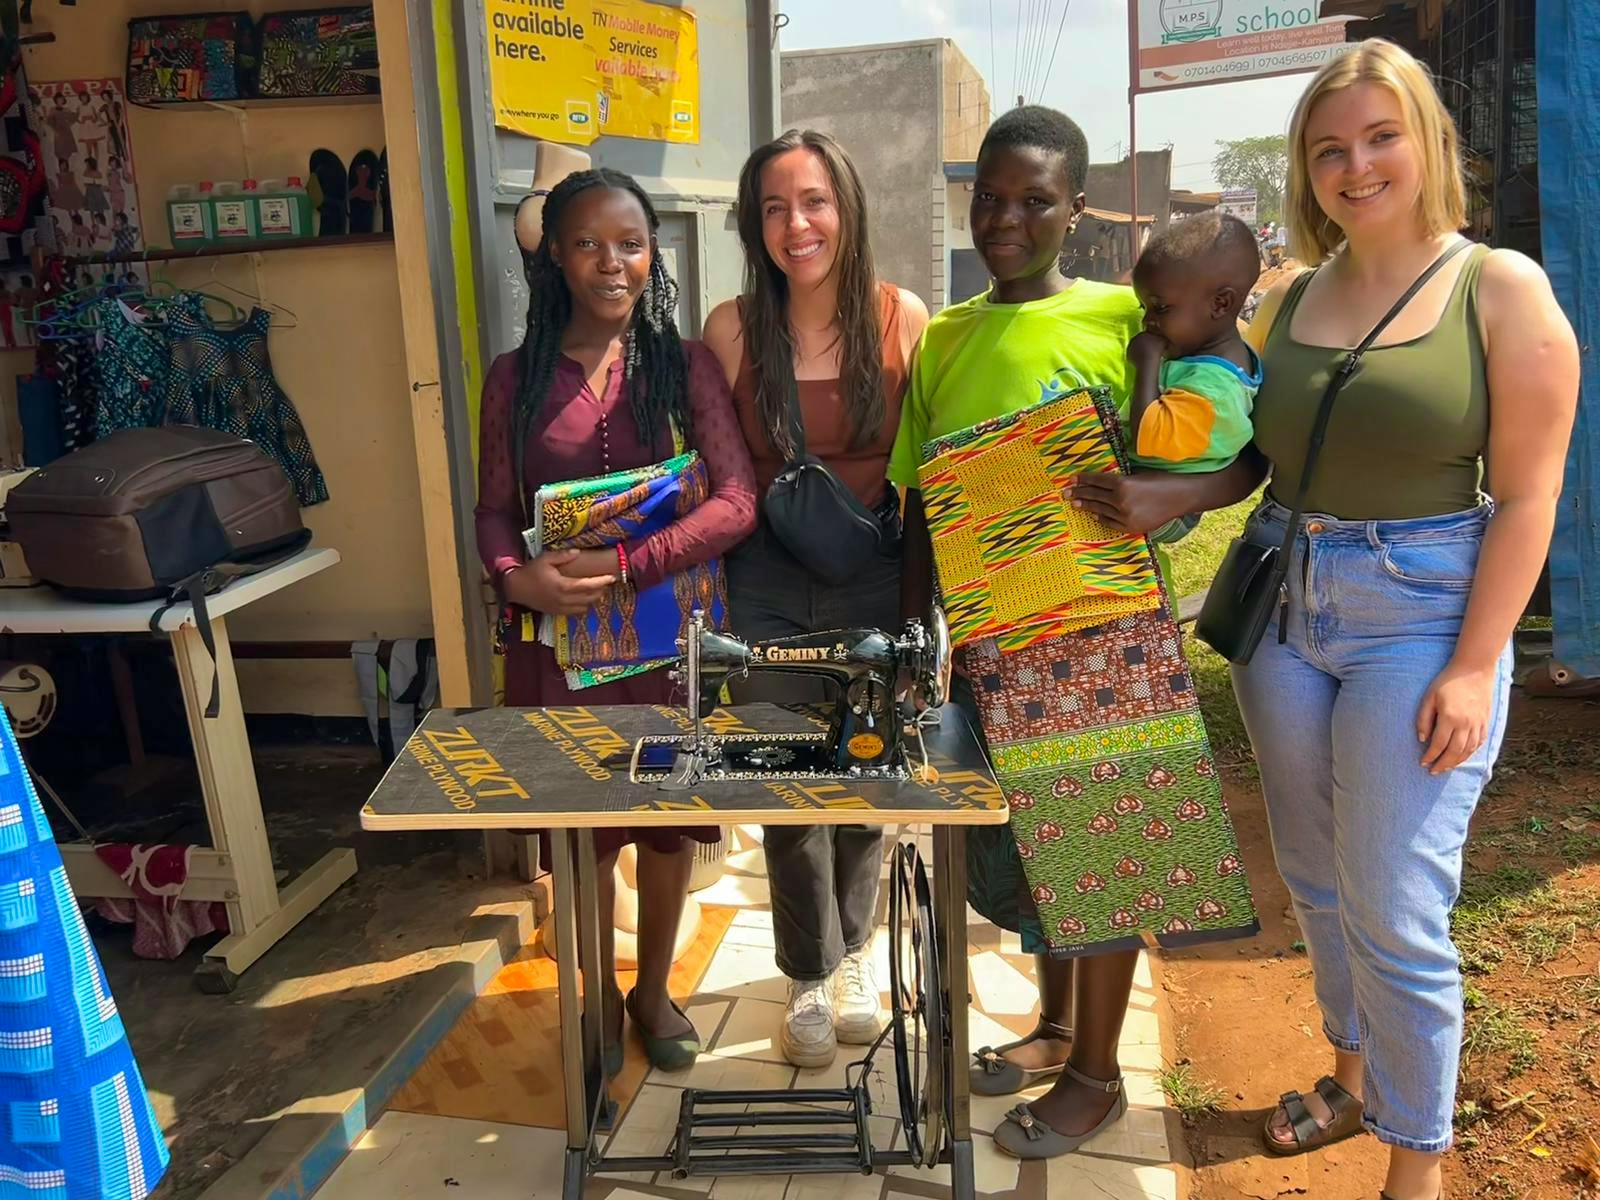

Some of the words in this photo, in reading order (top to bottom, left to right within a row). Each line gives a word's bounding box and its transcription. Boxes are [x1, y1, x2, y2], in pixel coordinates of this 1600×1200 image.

[493, 11, 584, 40] available
[608, 15, 645, 34] Mobile
[646, 22, 680, 44] Money
[495, 34, 546, 62] here.
[609, 37, 658, 58] Services
[550, 113, 560, 121] go
[766, 645, 831, 661] GEMINY
[522, 712, 566, 742] MARINE
[554, 739, 612, 781] PLYWOOD
[423, 763, 476, 810] PLYWOOD
